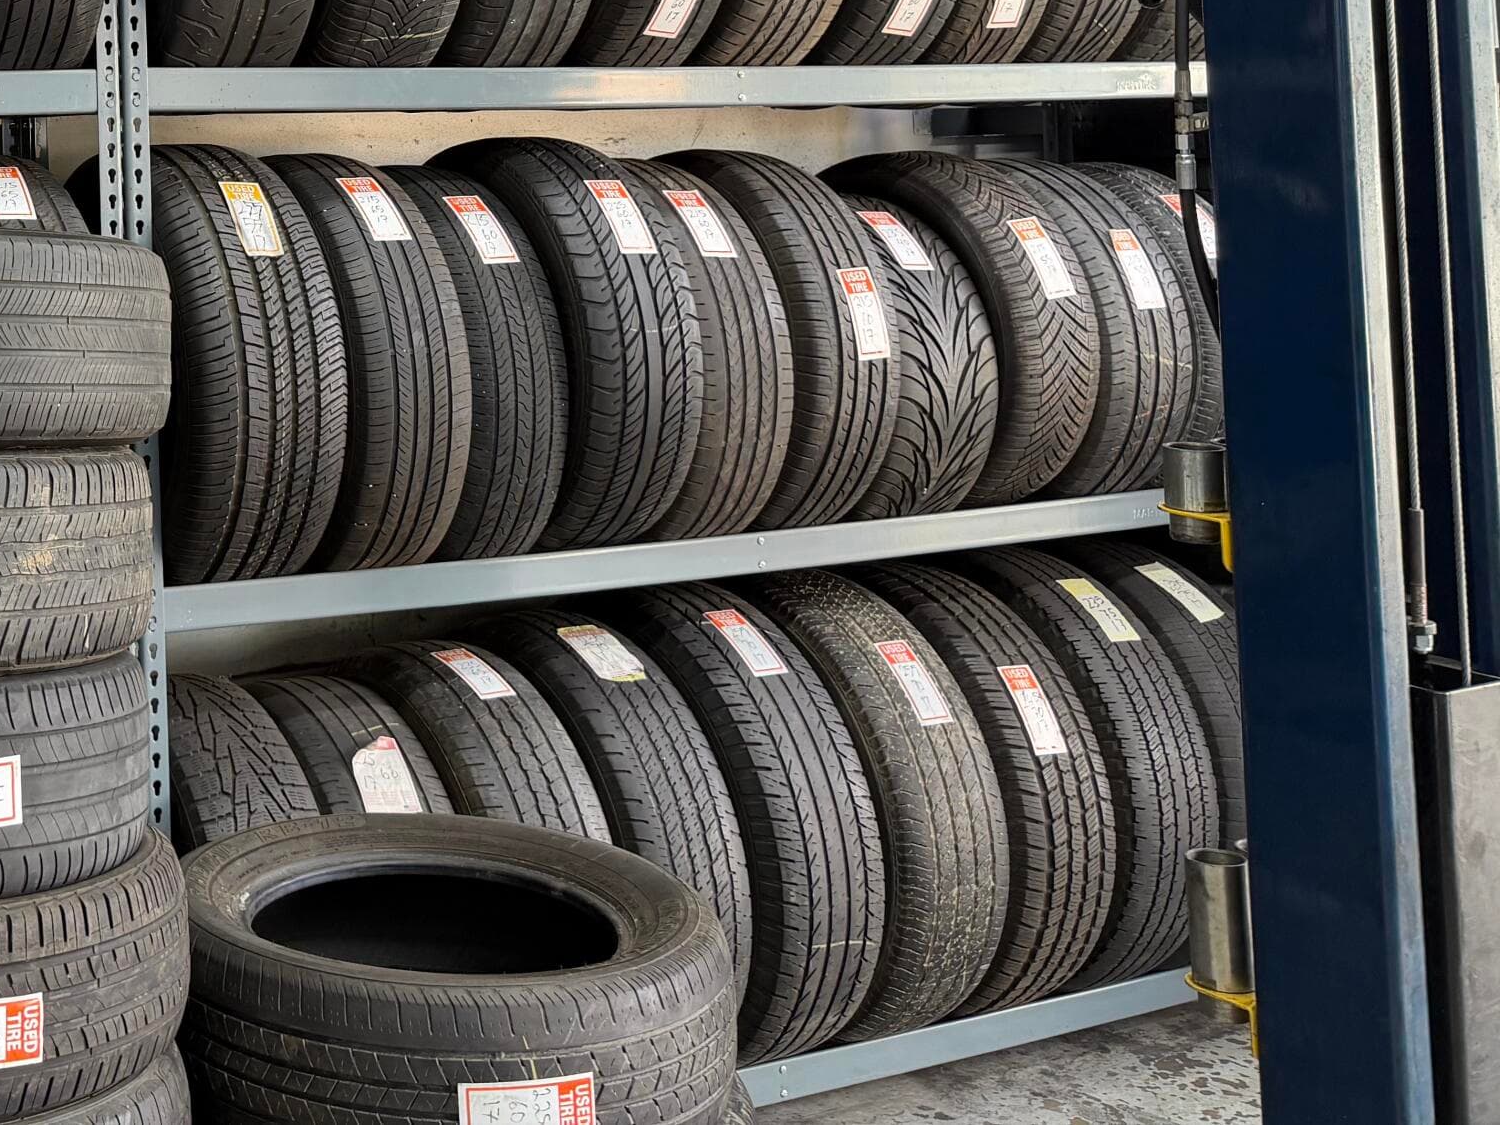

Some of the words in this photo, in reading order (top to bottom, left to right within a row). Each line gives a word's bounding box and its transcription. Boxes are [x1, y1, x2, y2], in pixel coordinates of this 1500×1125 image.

[595, 182, 618, 190] USED
[844, 271, 865, 282] USED
[851, 283, 869, 293] TIRE
[883, 645, 905, 654] USED
[7, 1011, 23, 1051] TIRE
[24, 1008, 38, 1053] USED
[560, 1090, 575, 1125] TIRE
